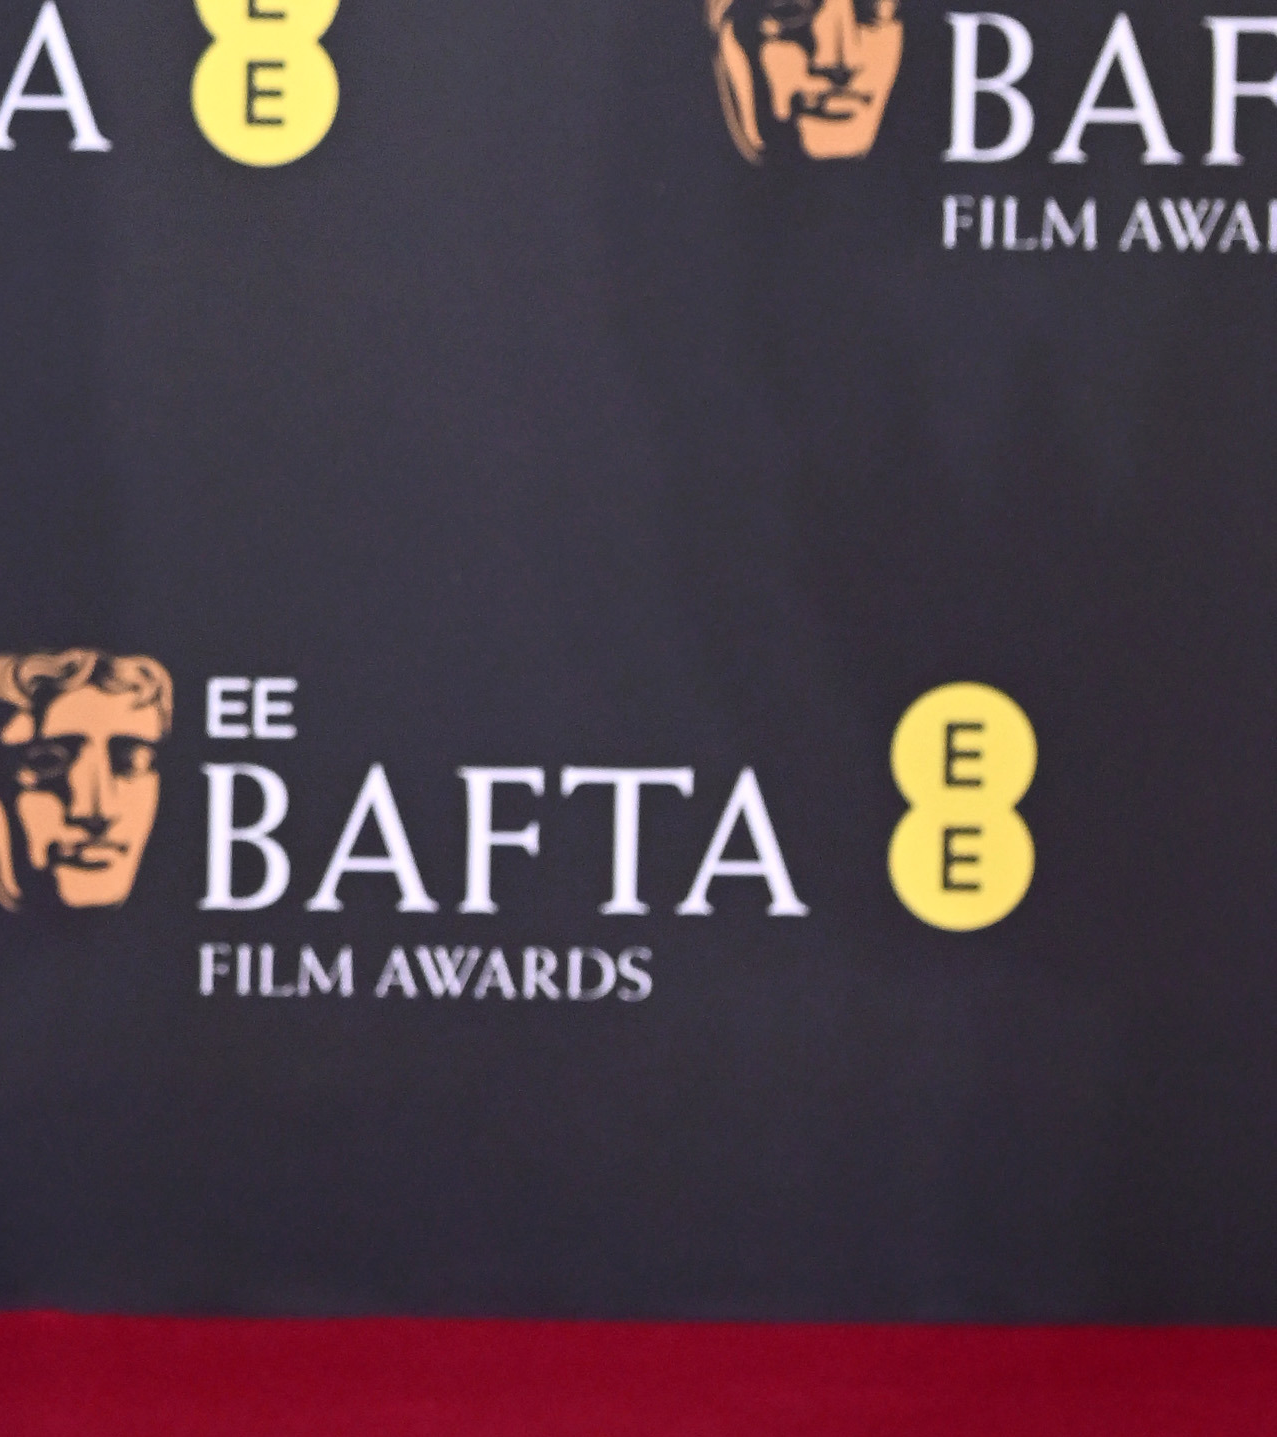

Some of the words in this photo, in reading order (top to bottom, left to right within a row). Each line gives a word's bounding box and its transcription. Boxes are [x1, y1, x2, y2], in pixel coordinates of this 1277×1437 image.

[945, 13, 1277, 165] BAF
[943, 196, 1097, 250] FILM
[1120, 199, 1277, 252] AWA
[207, 677, 297, 739] EE
[201, 764, 808, 916] BAFTA
[200, 944, 353, 996] FILM
[376, 947, 652, 1000] AWARDS
